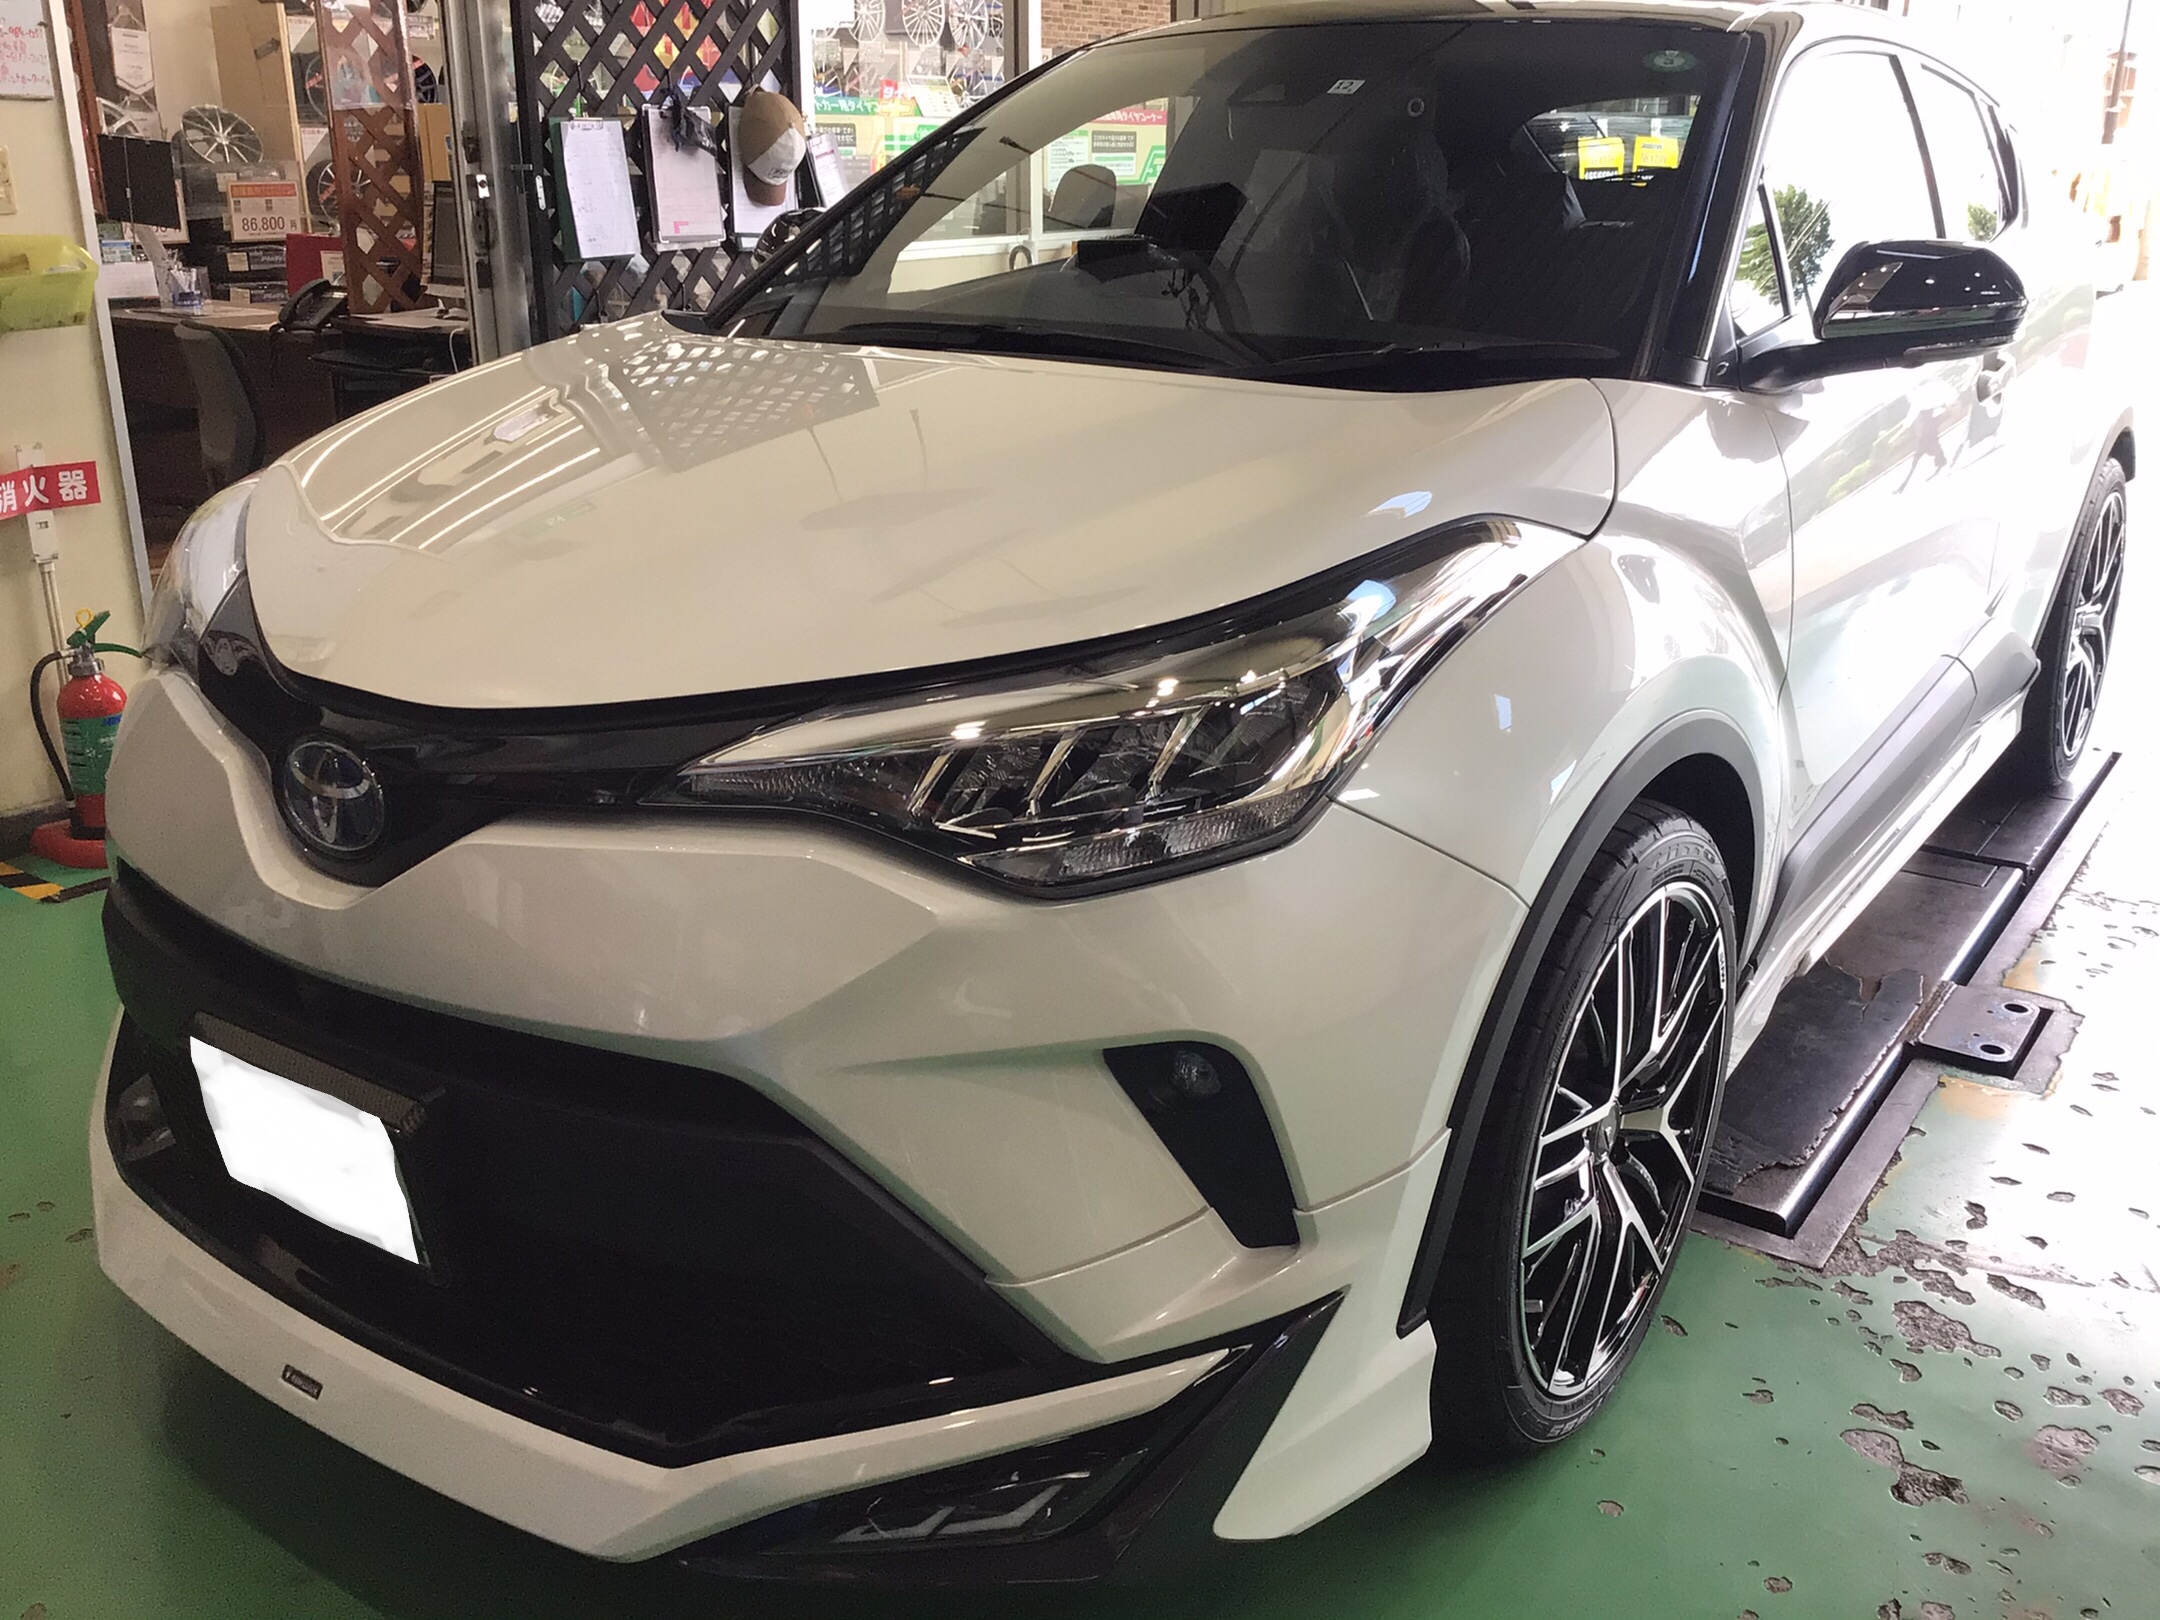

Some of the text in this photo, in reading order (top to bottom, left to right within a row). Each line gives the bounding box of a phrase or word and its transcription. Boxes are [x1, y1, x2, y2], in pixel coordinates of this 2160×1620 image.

[242, 216, 285, 232] 86,800
[0, 469, 88, 514] 消火器
